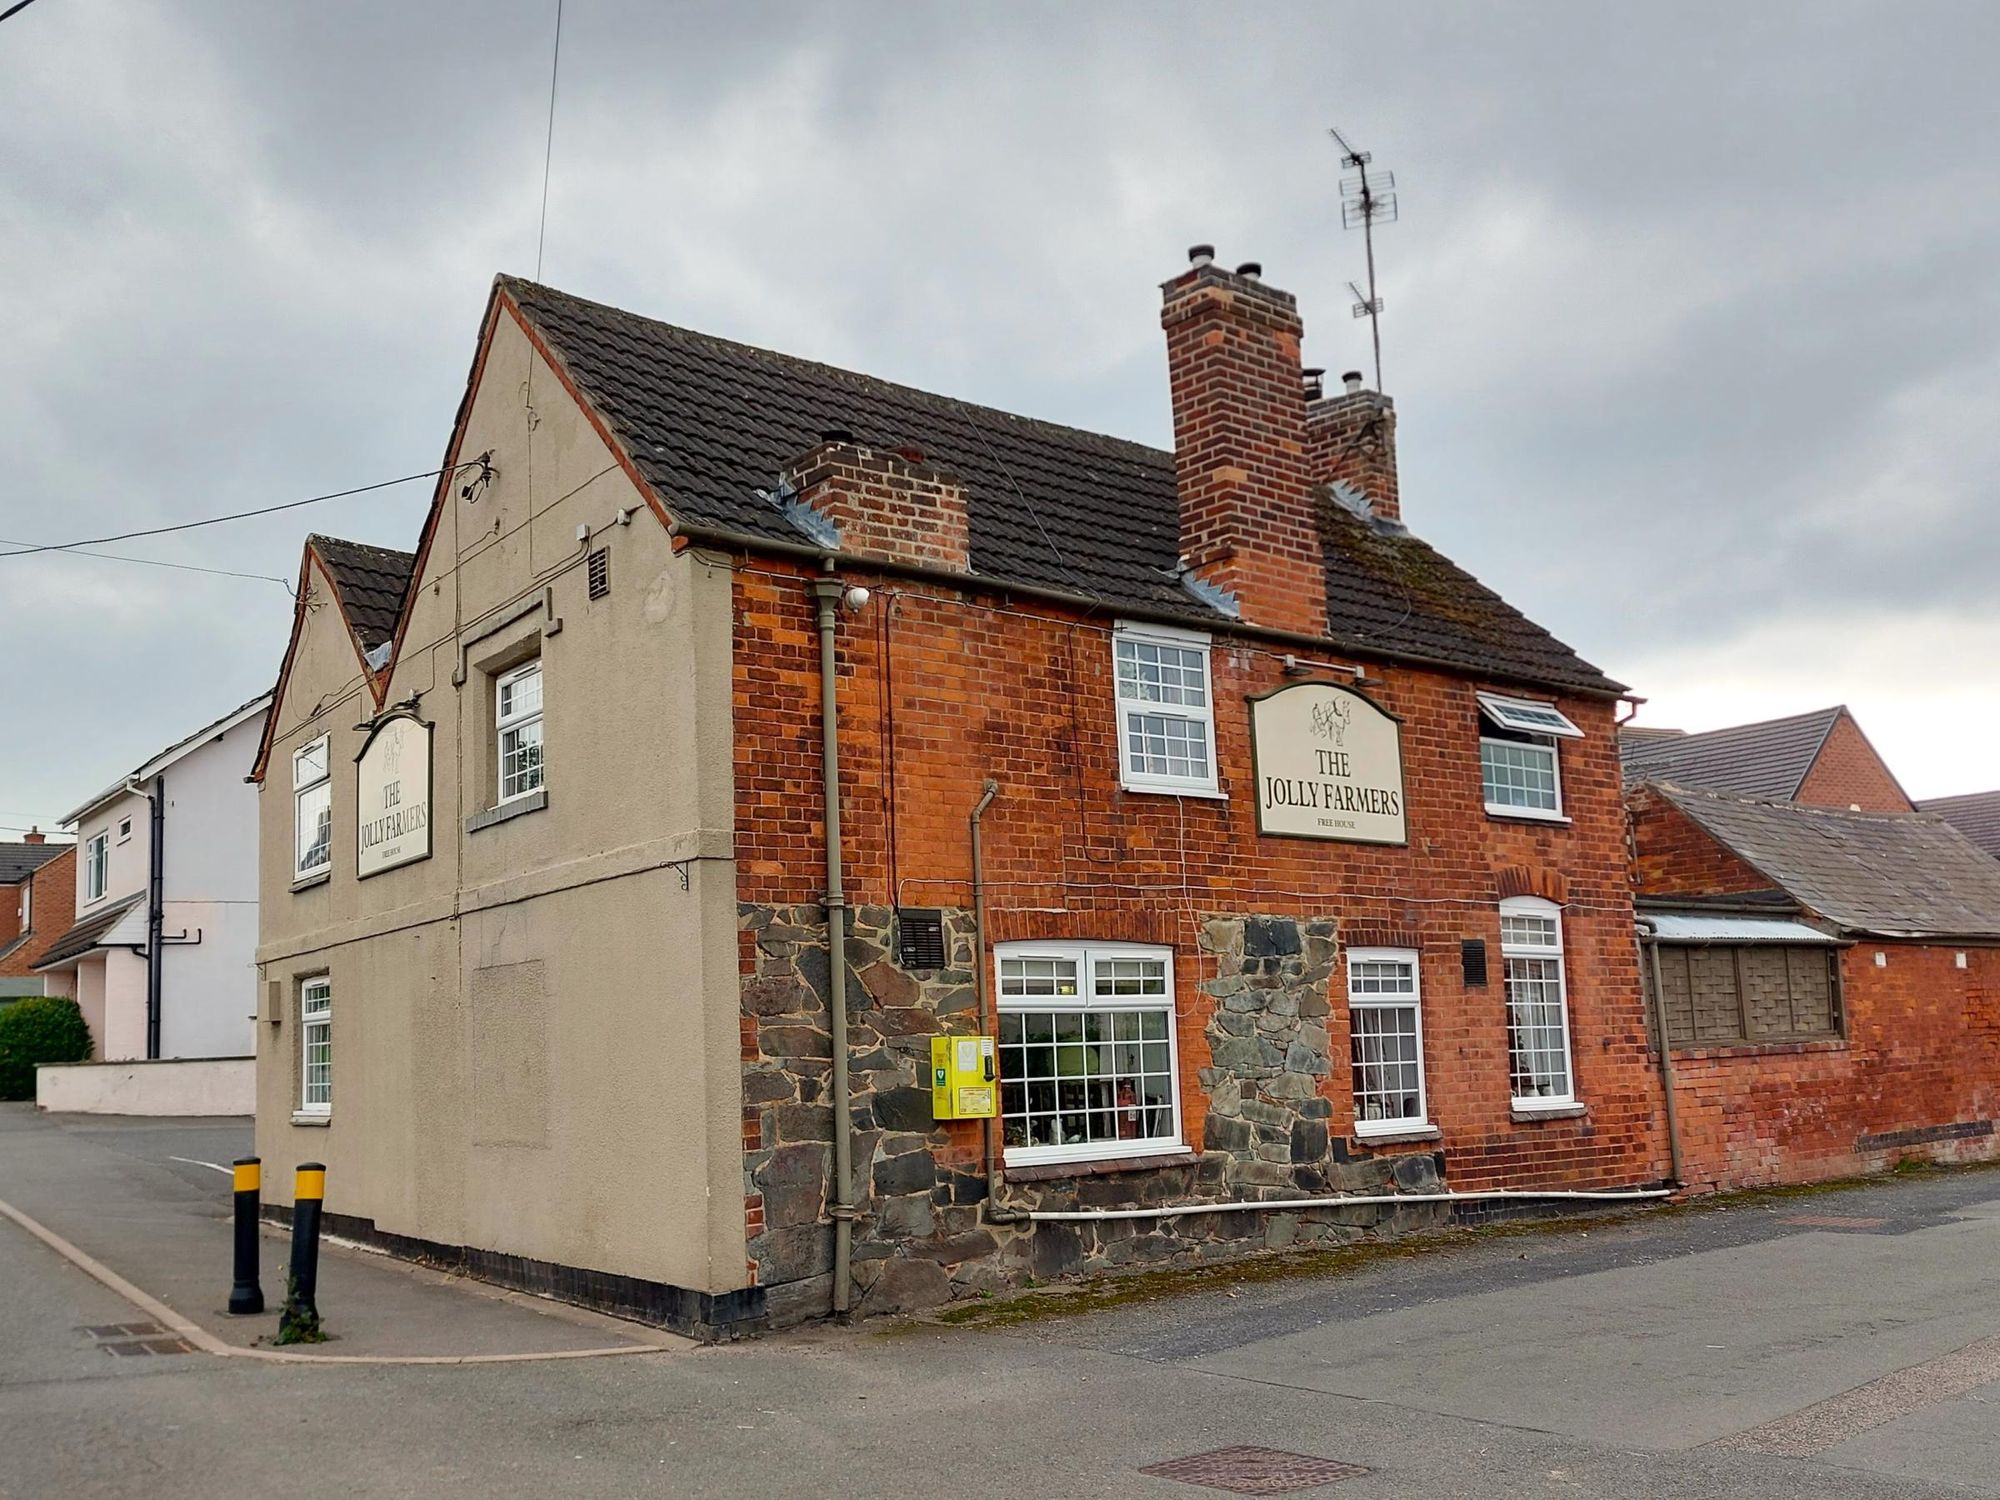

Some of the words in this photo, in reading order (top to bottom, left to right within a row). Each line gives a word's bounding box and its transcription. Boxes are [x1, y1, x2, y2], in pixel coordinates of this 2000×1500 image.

[1315, 749, 1350, 777] THE
[384, 780, 401, 809] THE
[1266, 777, 1318, 809] JOLLY
[1323, 784, 1399, 816] FARMERS
[361, 818, 385, 855] JOLLY
[385, 801, 426, 841] FARMERS
[1317, 818, 1333, 827] FREE
[1334, 819, 1356, 829] HOUSE
